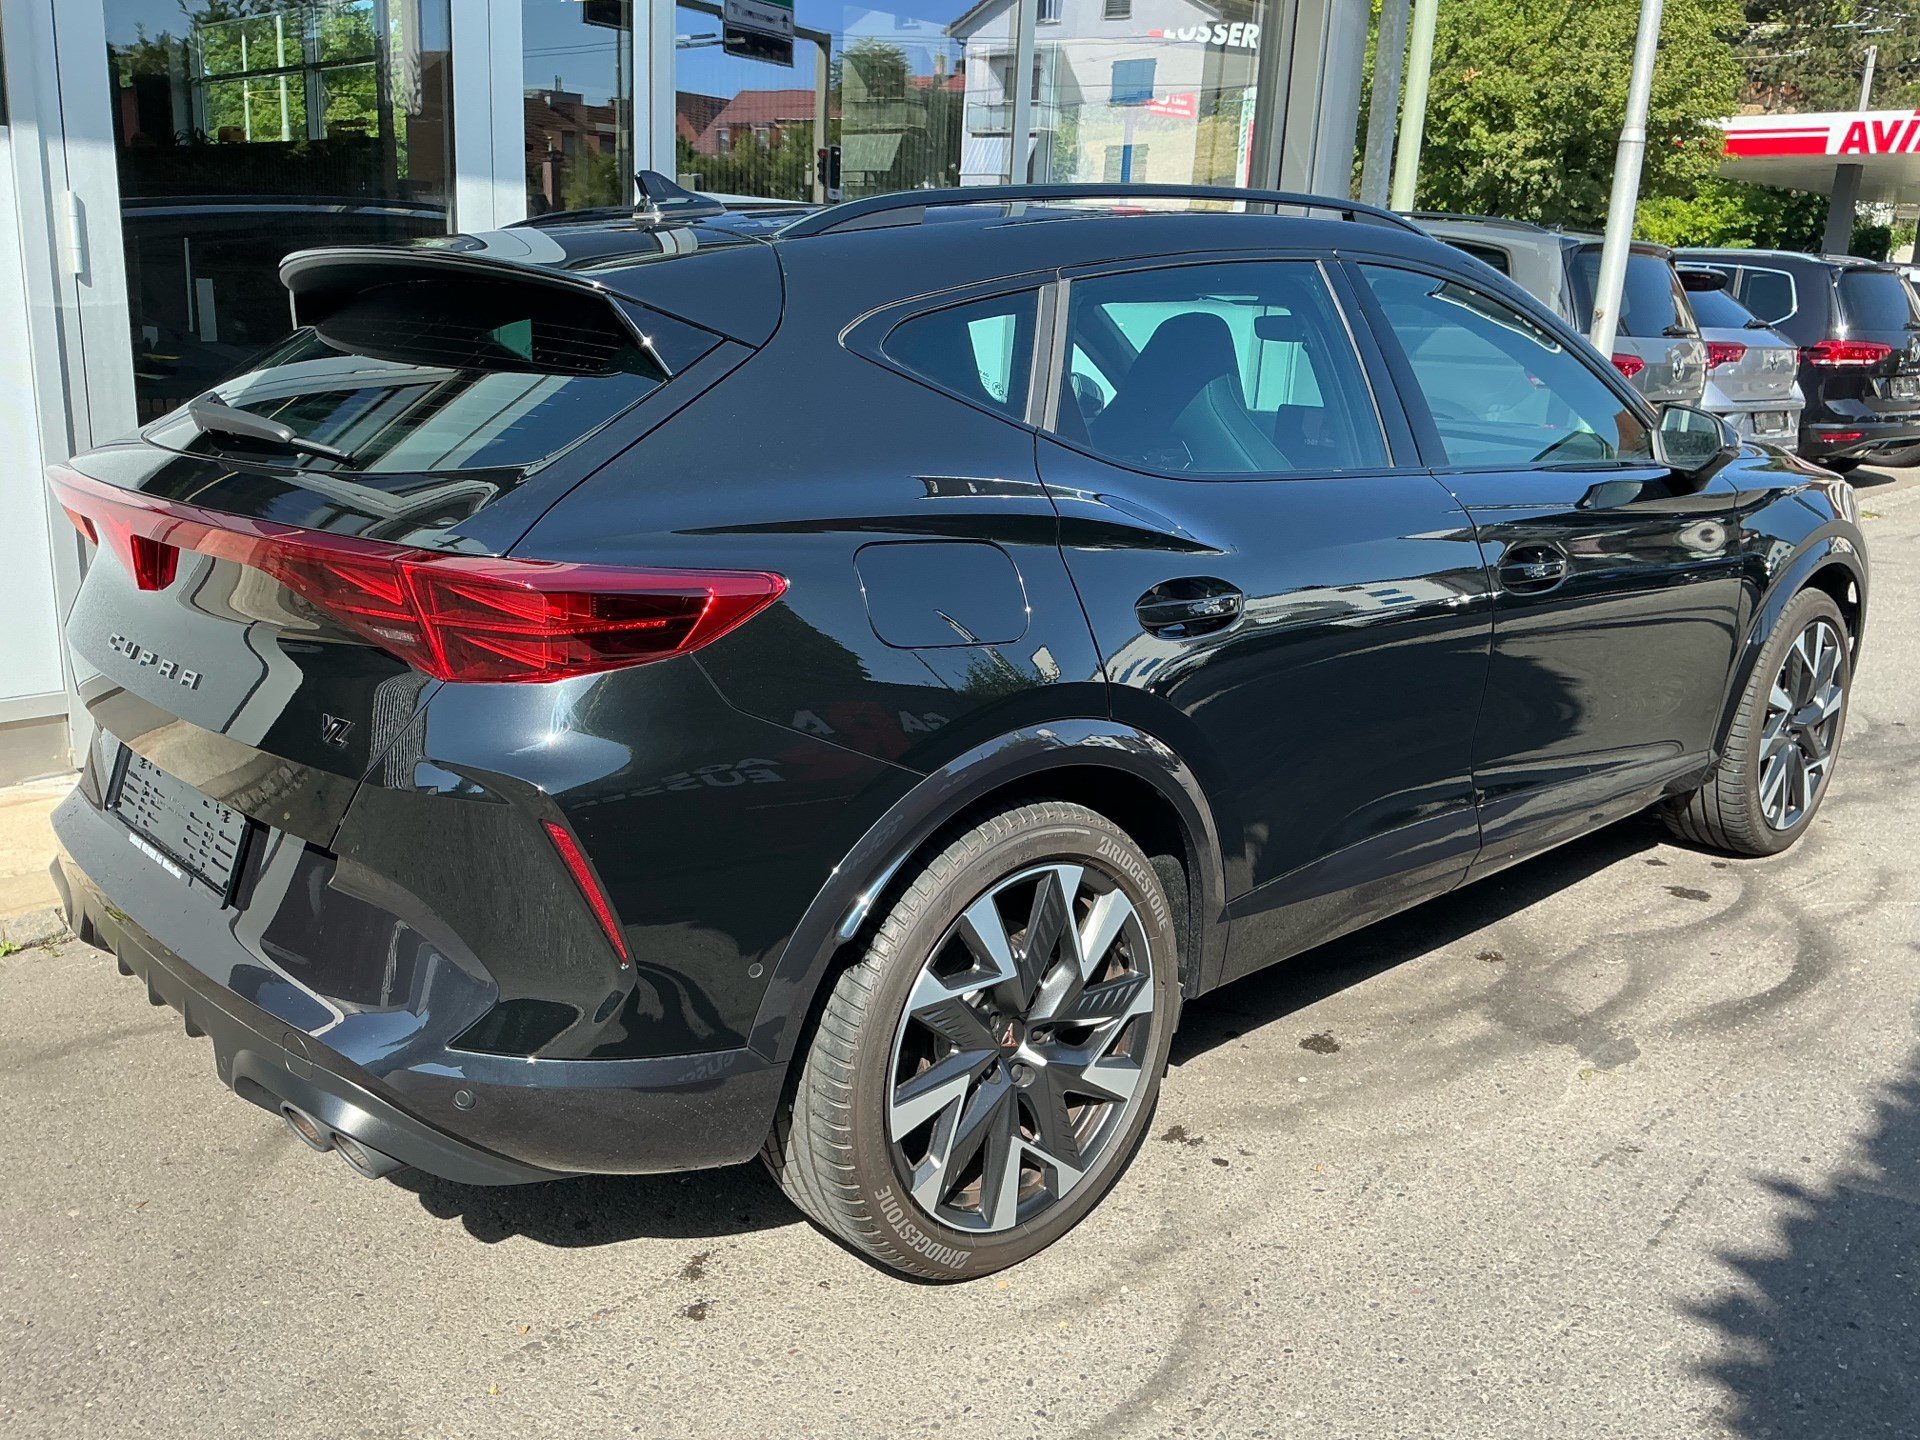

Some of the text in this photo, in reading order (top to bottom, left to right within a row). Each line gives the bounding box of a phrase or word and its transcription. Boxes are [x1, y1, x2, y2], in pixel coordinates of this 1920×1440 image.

[1838, 119, 1920, 155] AVI
[107, 632, 204, 691] CUPRA
[322, 712, 356, 751] VZ
[1096, 835, 1169, 932] BRIDGESTONE
[874, 1185, 973, 1270] BRIDGESTONE
